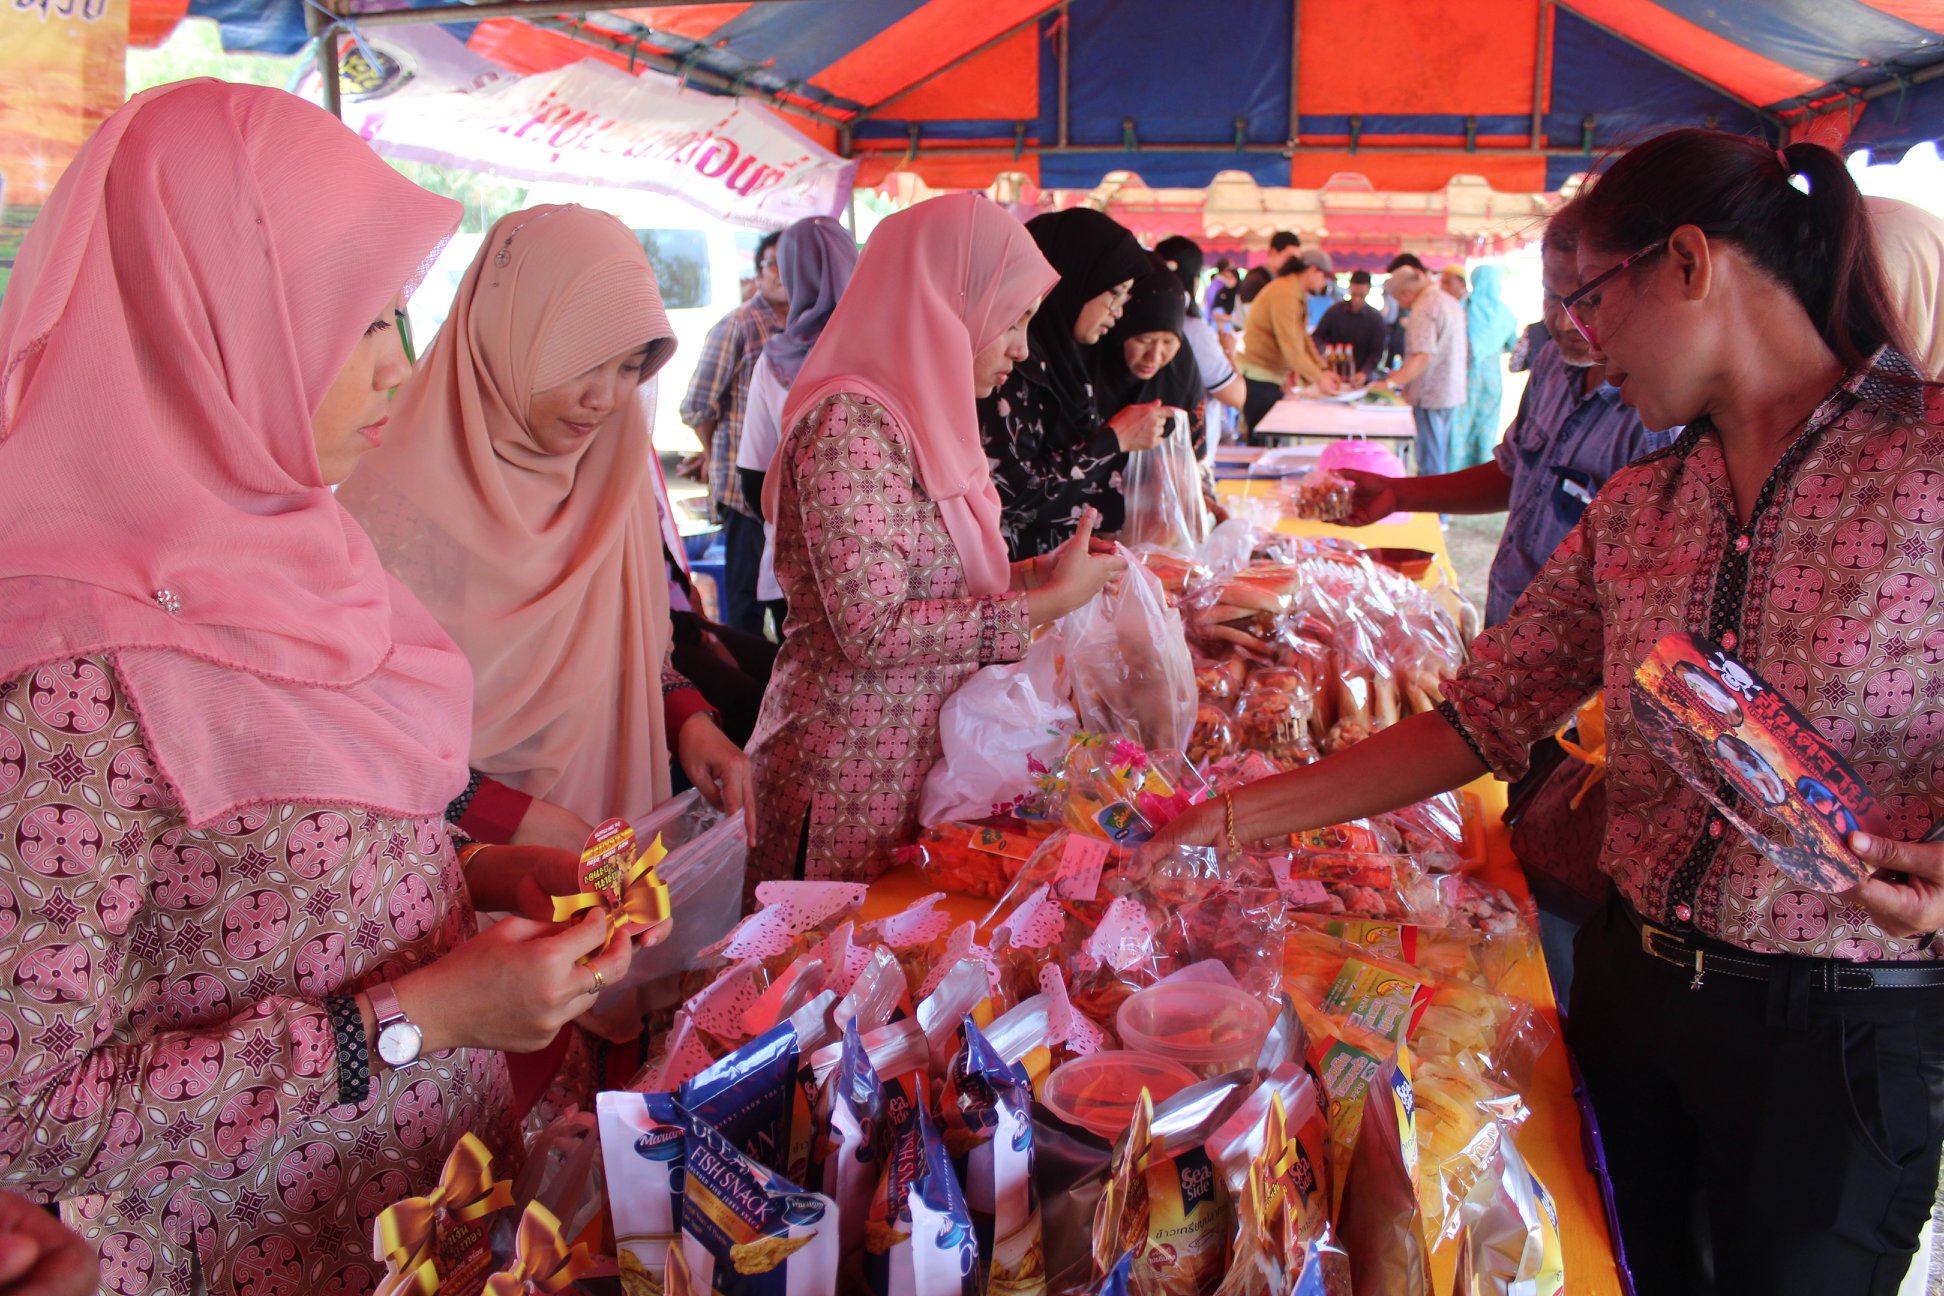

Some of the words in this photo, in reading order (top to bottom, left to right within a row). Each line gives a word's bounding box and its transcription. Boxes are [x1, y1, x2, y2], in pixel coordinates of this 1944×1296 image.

[1182, 1165, 1211, 1189] Sea
[1288, 1157, 1310, 1181] Sea
[690, 1145, 726, 1181] FISH
[719, 1169, 775, 1224] SNACK
